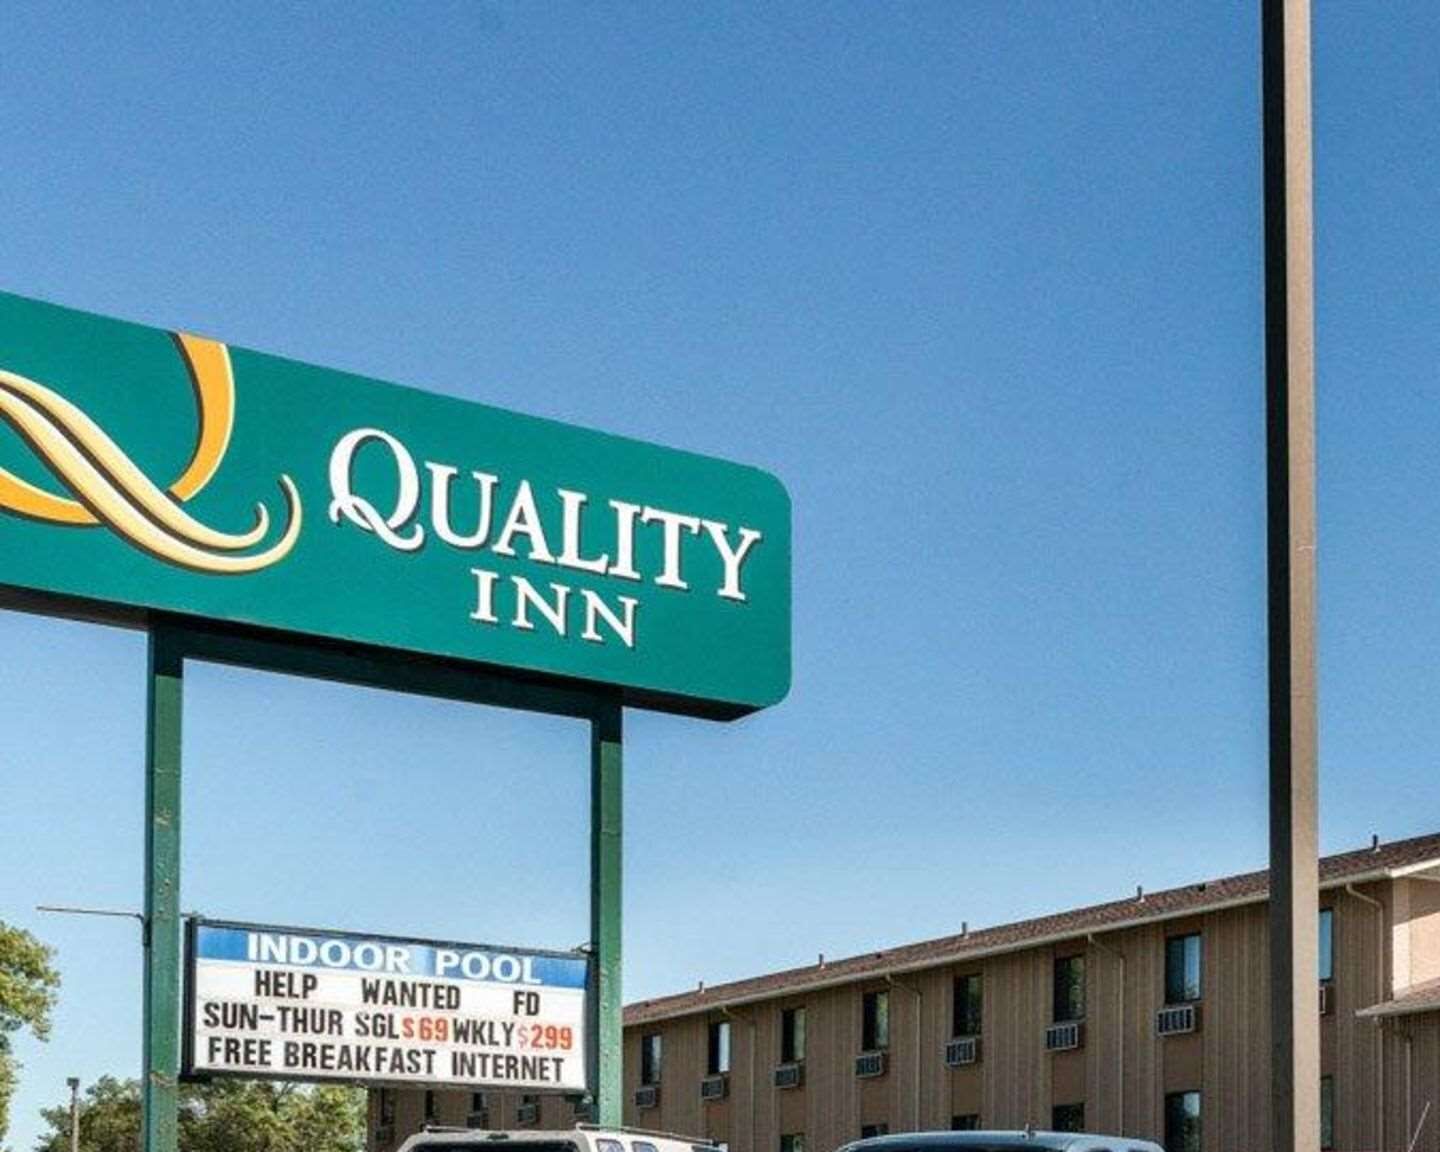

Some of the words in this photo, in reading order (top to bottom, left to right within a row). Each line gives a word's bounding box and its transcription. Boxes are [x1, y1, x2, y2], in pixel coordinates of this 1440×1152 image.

[329, 428, 761, 601] QUALITY
[470, 568, 639, 648] INN
[247, 933, 411, 974] INDOOR
[434, 950, 543, 985] POOL
[255, 970, 318, 999] HELP
[362, 977, 461, 1010] WANTED
[513, 990, 541, 1016] FD
[204, 1002, 343, 1035] SUN-THUR
[453, 1017, 515, 1046] WKLY
[517, 1024, 572, 1050] $299
[208, 1036, 271, 1066] FREE
[284, 1041, 436, 1074] BREAKFAST
[451, 1051, 565, 1082] INTERNET
